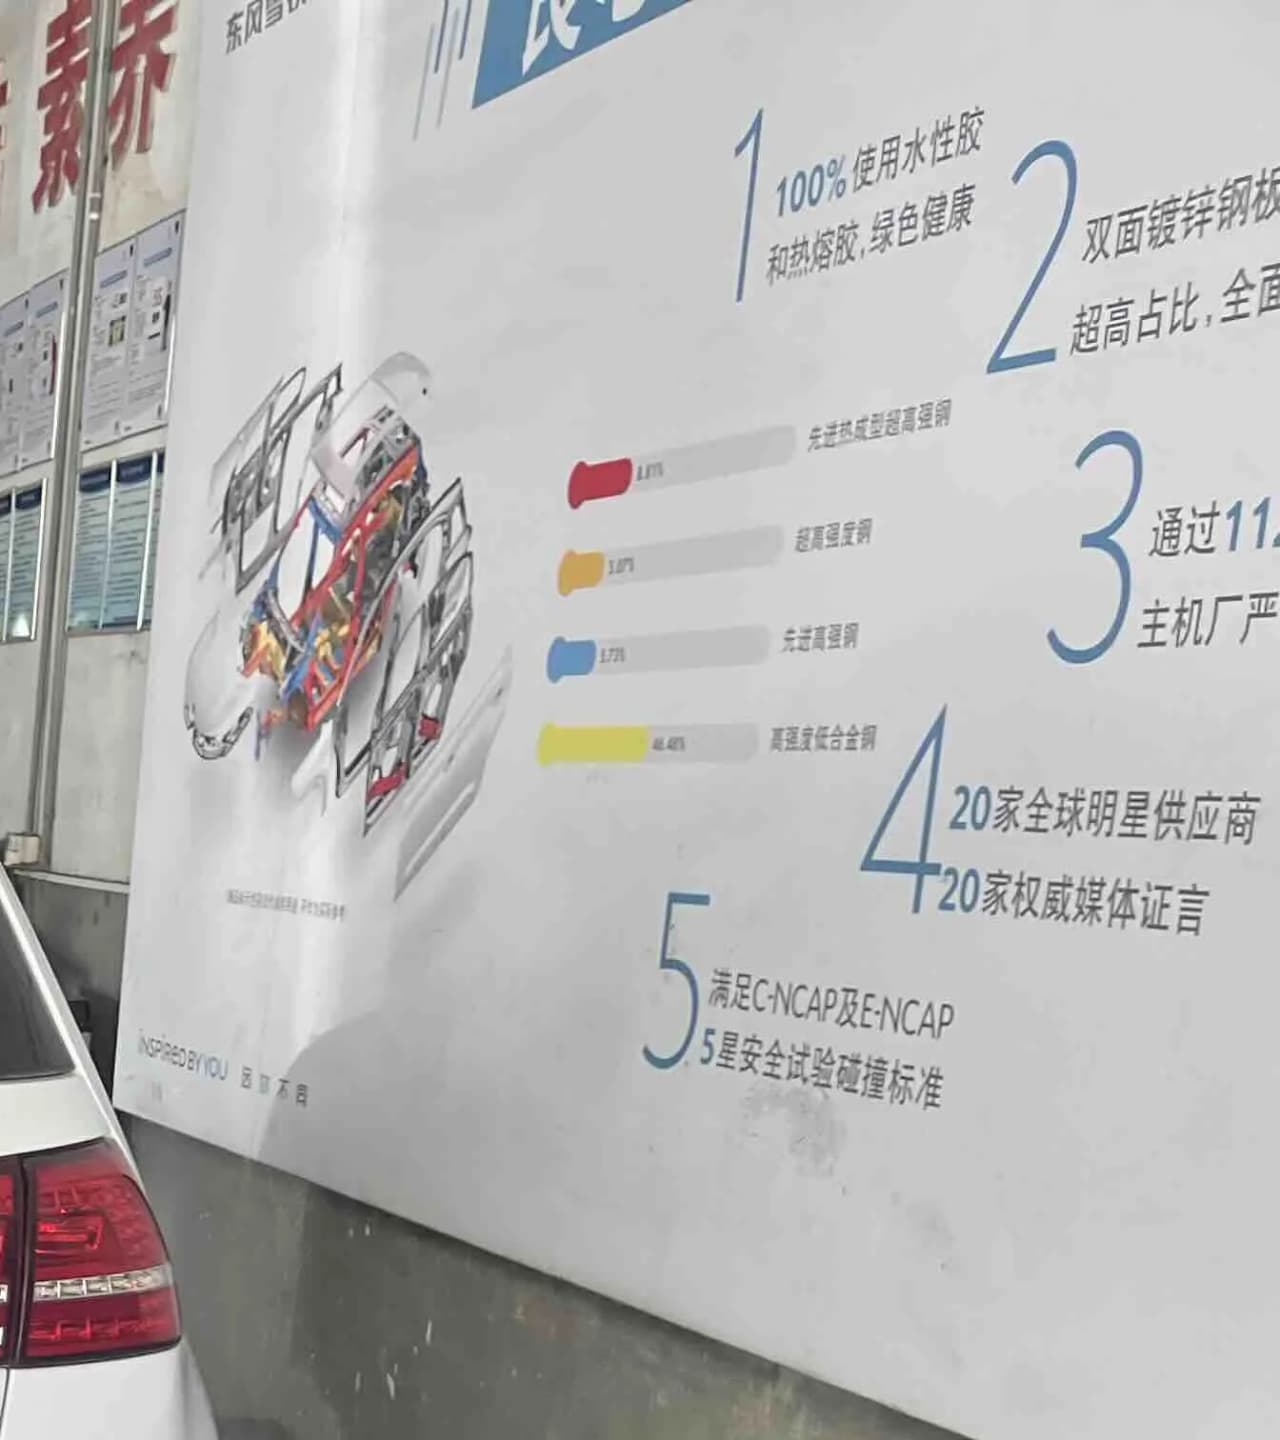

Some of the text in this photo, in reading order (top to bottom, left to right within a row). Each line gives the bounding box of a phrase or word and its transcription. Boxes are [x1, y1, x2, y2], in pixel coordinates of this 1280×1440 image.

[734, 107, 764, 303] 1
[776, 106, 985, 218] 100%使用水性胶
[986, 139, 1078, 374] 2
[1046, 430, 1143, 664] 3
[1148, 497, 1280, 557] 通过11
[1137, 592, 1279, 648] 主机厂严
[860, 703, 947, 914] 4
[949, 784, 1262, 846] 20家全球明星供应商
[938, 865, 1210, 936] 20家权威媒体证言
[643, 892, 711, 1070] 5
[700, 1028, 944, 1111] 5星安全试验碰撞标准
